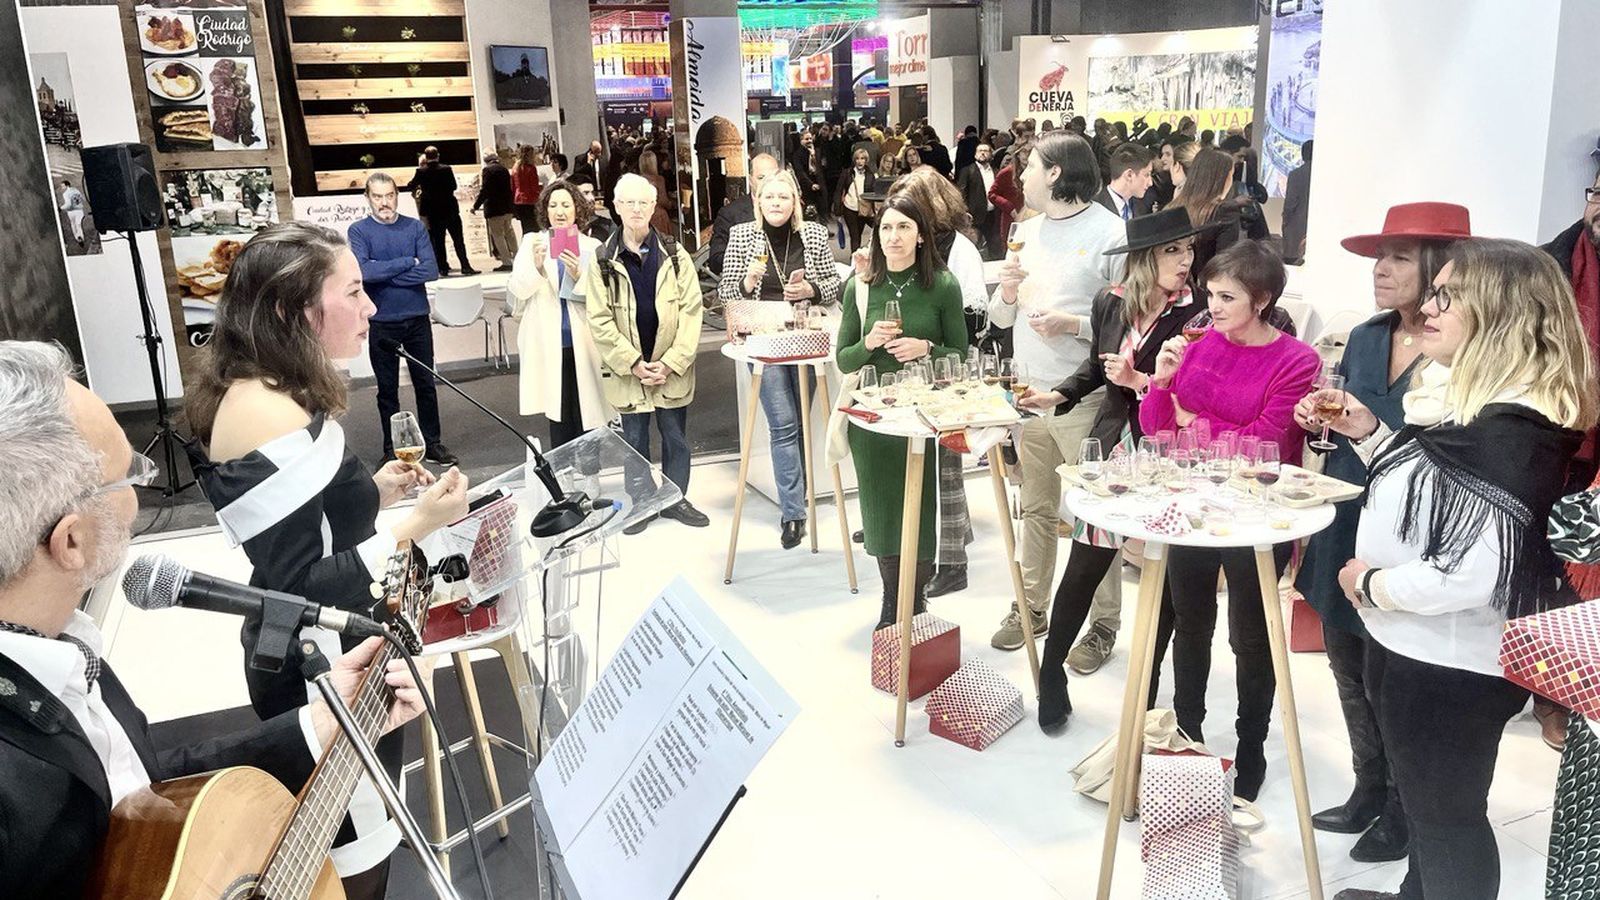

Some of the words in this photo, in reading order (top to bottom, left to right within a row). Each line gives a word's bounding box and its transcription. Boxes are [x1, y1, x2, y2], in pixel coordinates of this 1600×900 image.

[196, 15, 248, 34] Ciudad
[196, 29, 252, 53] Rodrigo
[686, 19, 705, 123] Almeida
[1029, 91, 1074, 103] CUEVA
